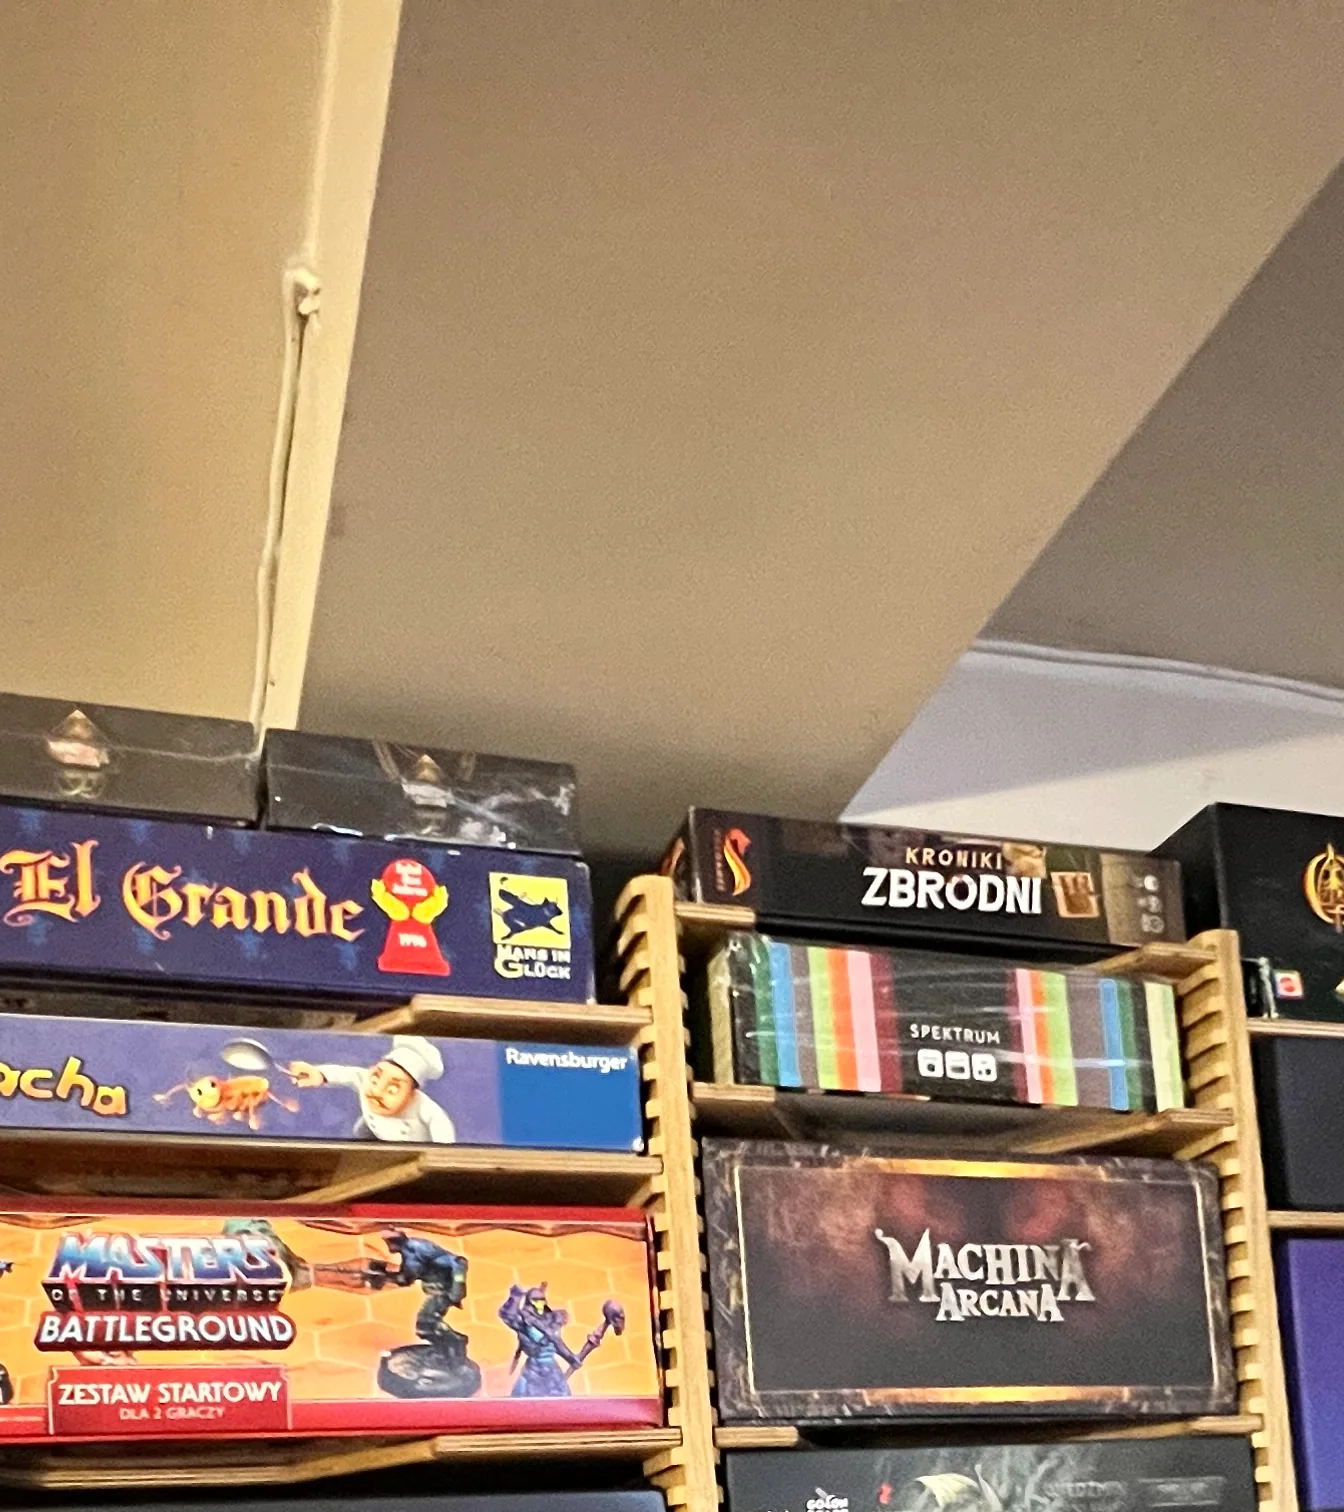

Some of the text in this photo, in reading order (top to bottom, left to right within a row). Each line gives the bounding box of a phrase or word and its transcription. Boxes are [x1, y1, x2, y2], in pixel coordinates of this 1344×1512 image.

[905, 846, 1003, 871] KRONIKI
[120, 860, 367, 942] Grande
[860, 866, 1043, 915] ZBRODNI
[909, 1023, 1001, 1044] SPEKTRUM
[505, 1047, 628, 1074] Ravensburger
[48, 1232, 287, 1282] MASTERS
[874, 1227, 1096, 1302] MACHINA
[935, 1282, 1065, 1322] ARCANA
[39, 1314, 294, 1343] BATTLEGROUND
[59, 1380, 283, 1405] ZESTAW STARTOWY
[119, 1406, 225, 1420] DLA 2 GRACZY
